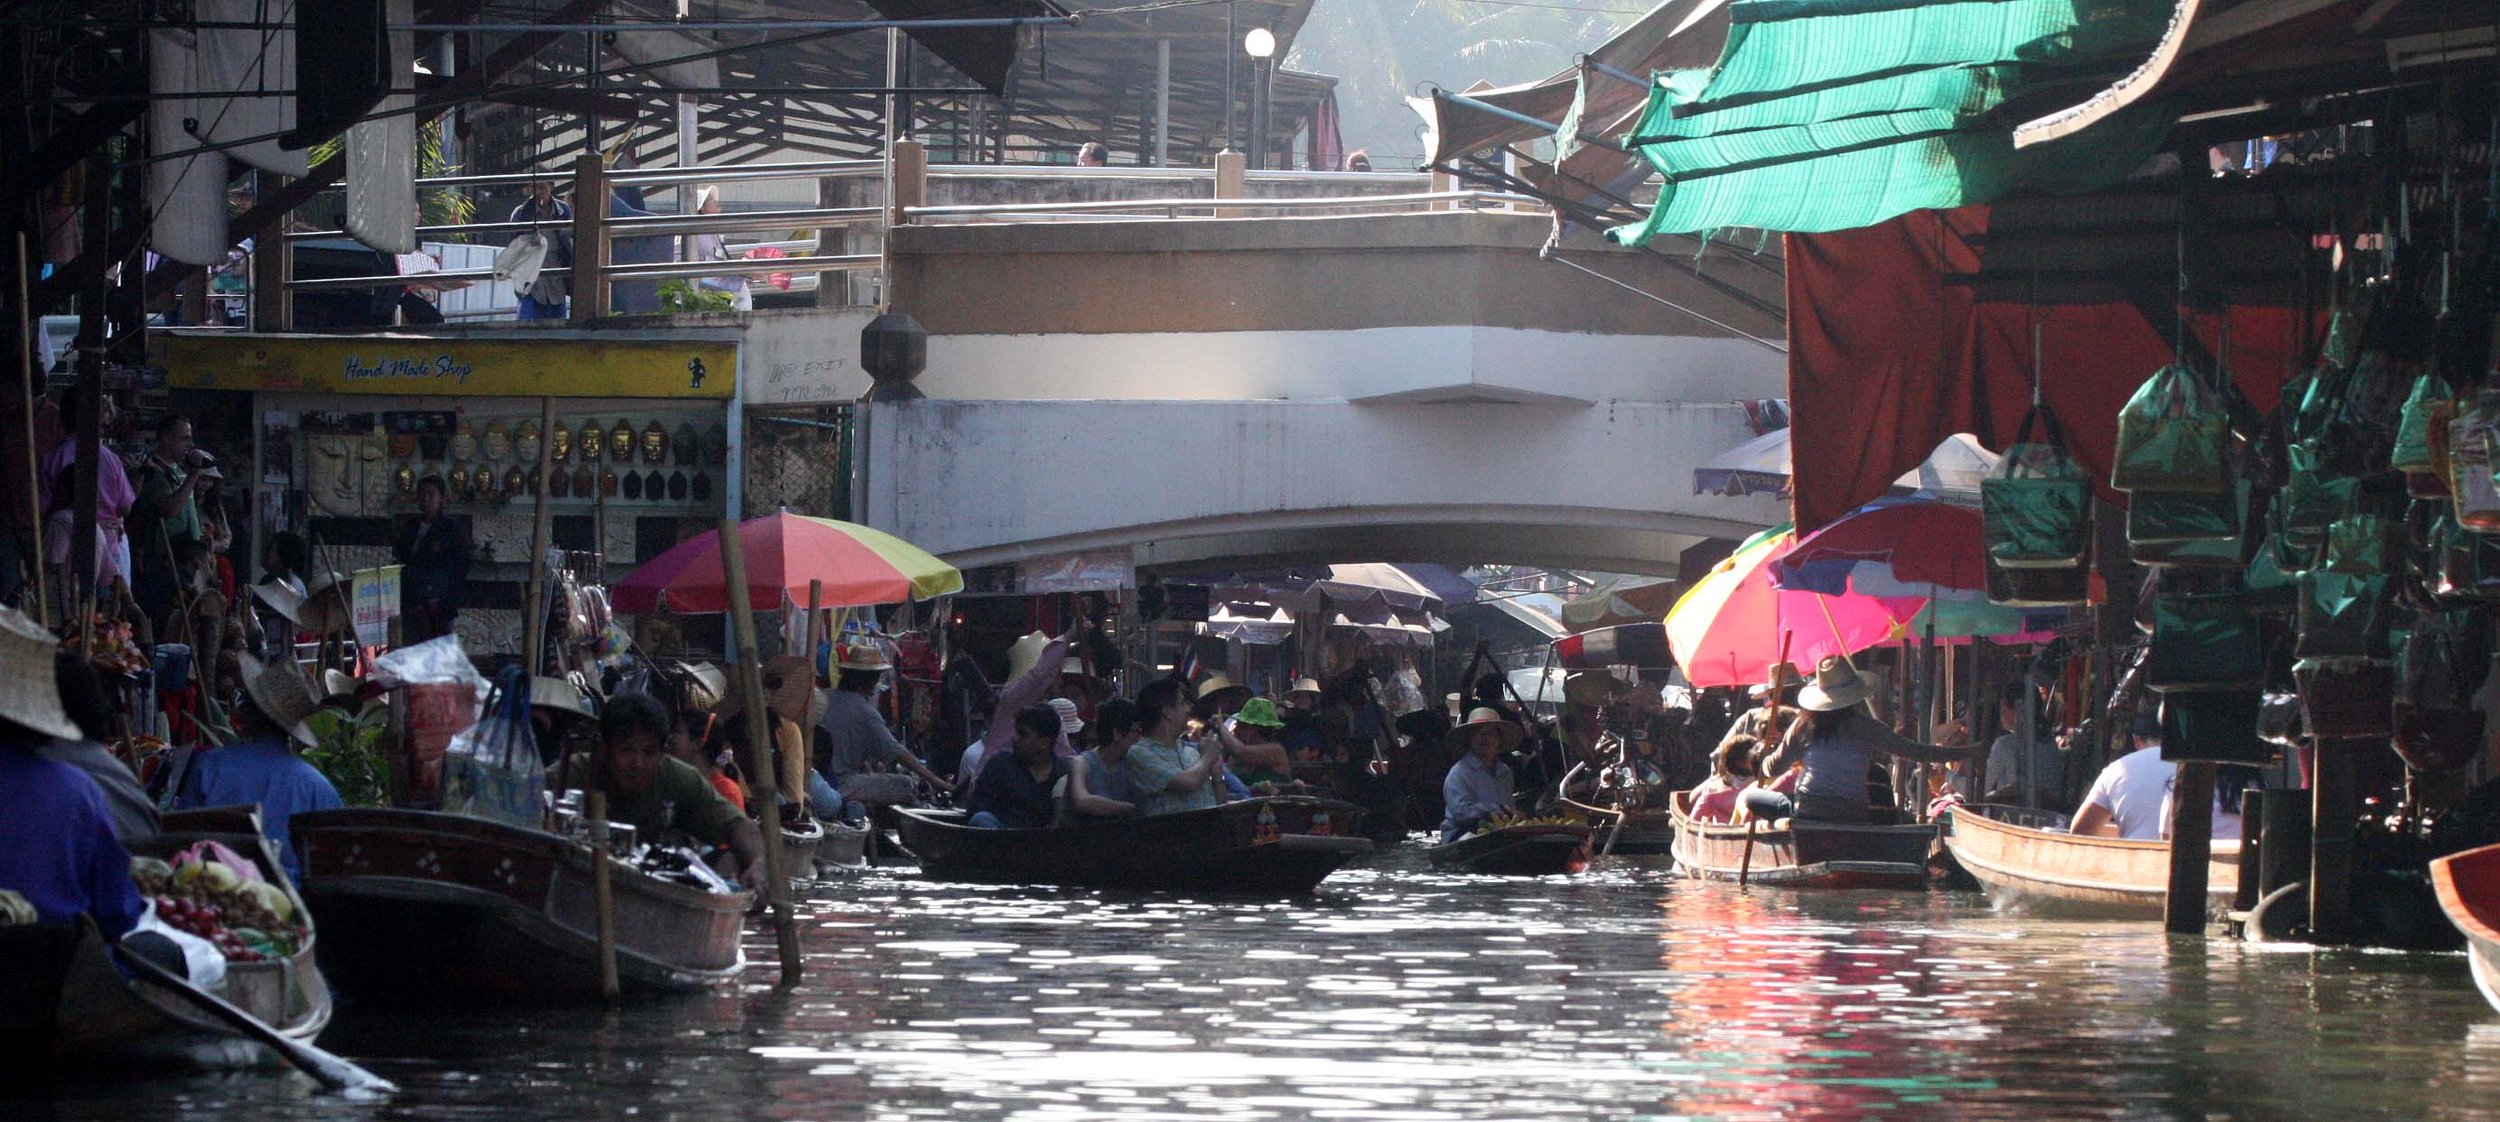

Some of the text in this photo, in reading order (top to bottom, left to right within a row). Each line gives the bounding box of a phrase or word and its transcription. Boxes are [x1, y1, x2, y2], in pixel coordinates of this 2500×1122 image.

[343, 354, 472, 384] Hand Made Shop
